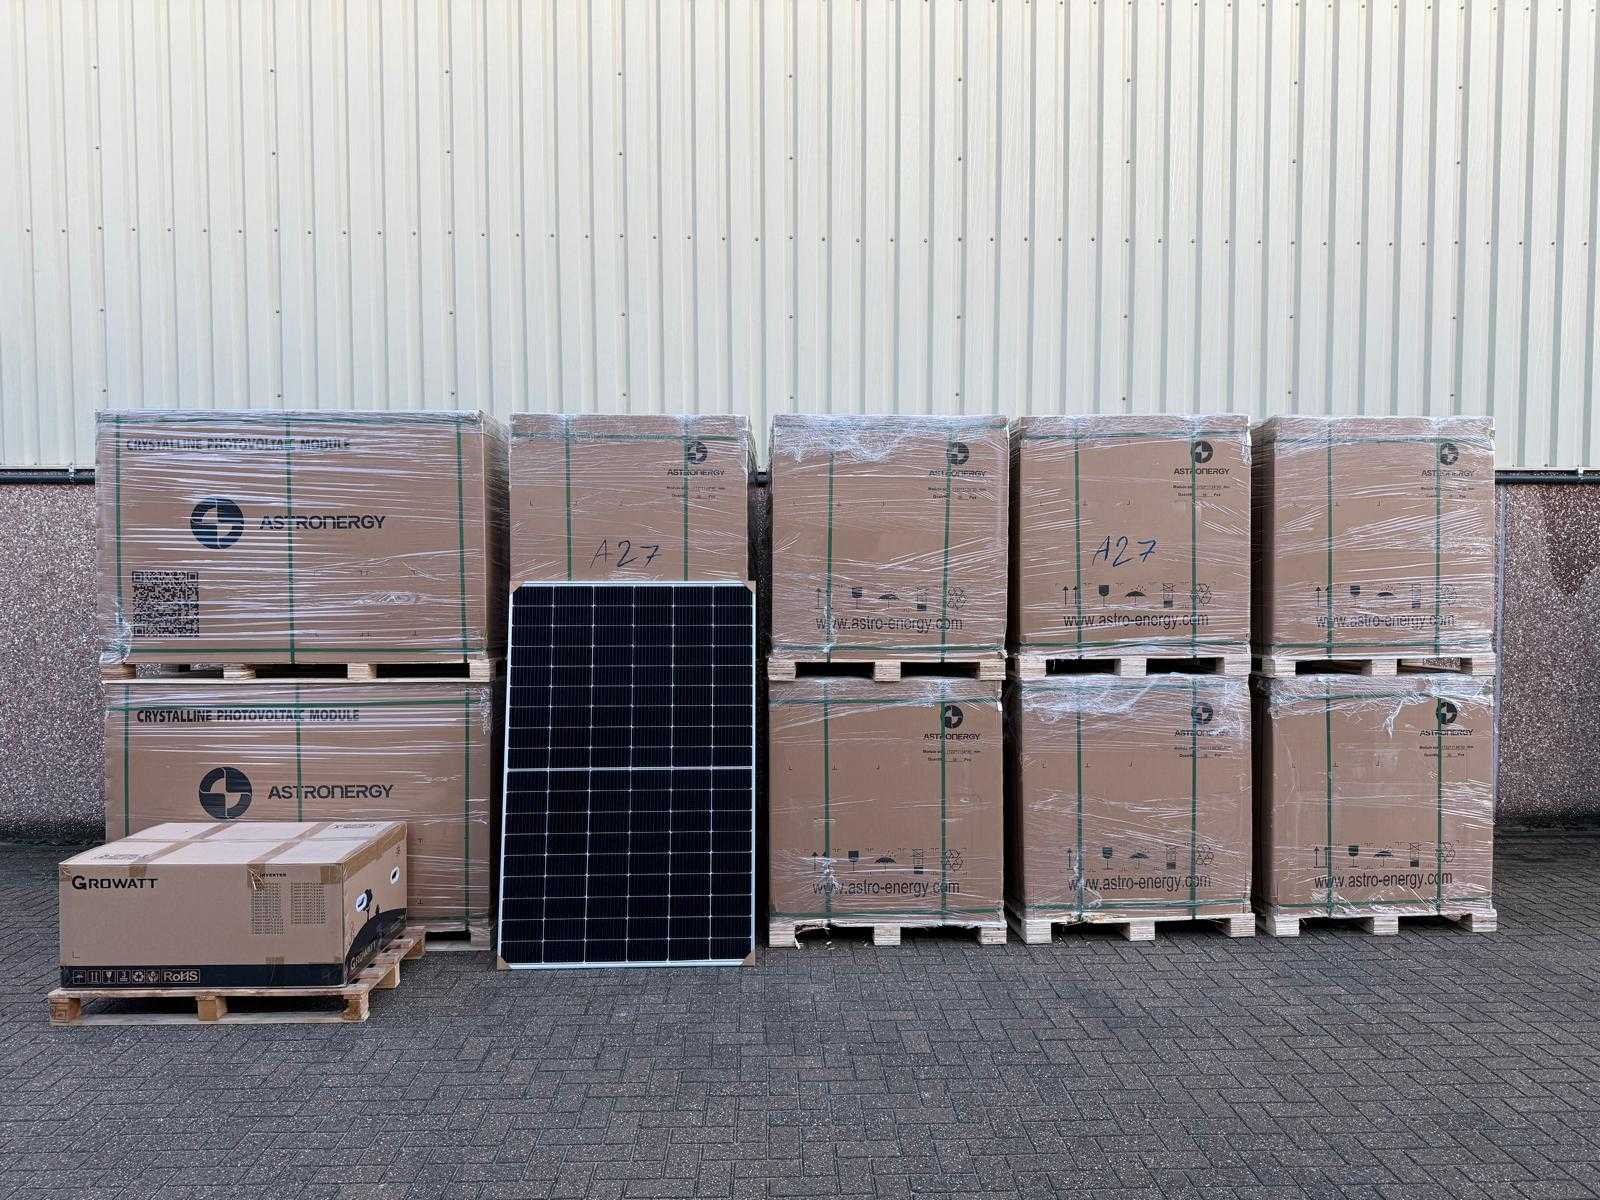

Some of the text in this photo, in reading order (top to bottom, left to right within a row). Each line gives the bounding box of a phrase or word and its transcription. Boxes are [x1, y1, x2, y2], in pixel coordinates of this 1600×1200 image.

[667, 468, 725, 476] ASTONERGY
[929, 469, 986, 477] ASTONERGY
[1421, 469, 1476, 477] ASTONERGY
[259, 515, 386, 530] ASTRONERGY
[590, 539, 662, 568] A27
[1092, 535, 1157, 567] A27
[1316, 613, 1456, 630] ww.astro-energy.com
[136, 709, 214, 723] CRYSTALLINE
[309, 709, 360, 722] MODULE
[267, 783, 395, 800] ASTRONERGY
[1067, 874, 1212, 892] ww.astro-energy.com
